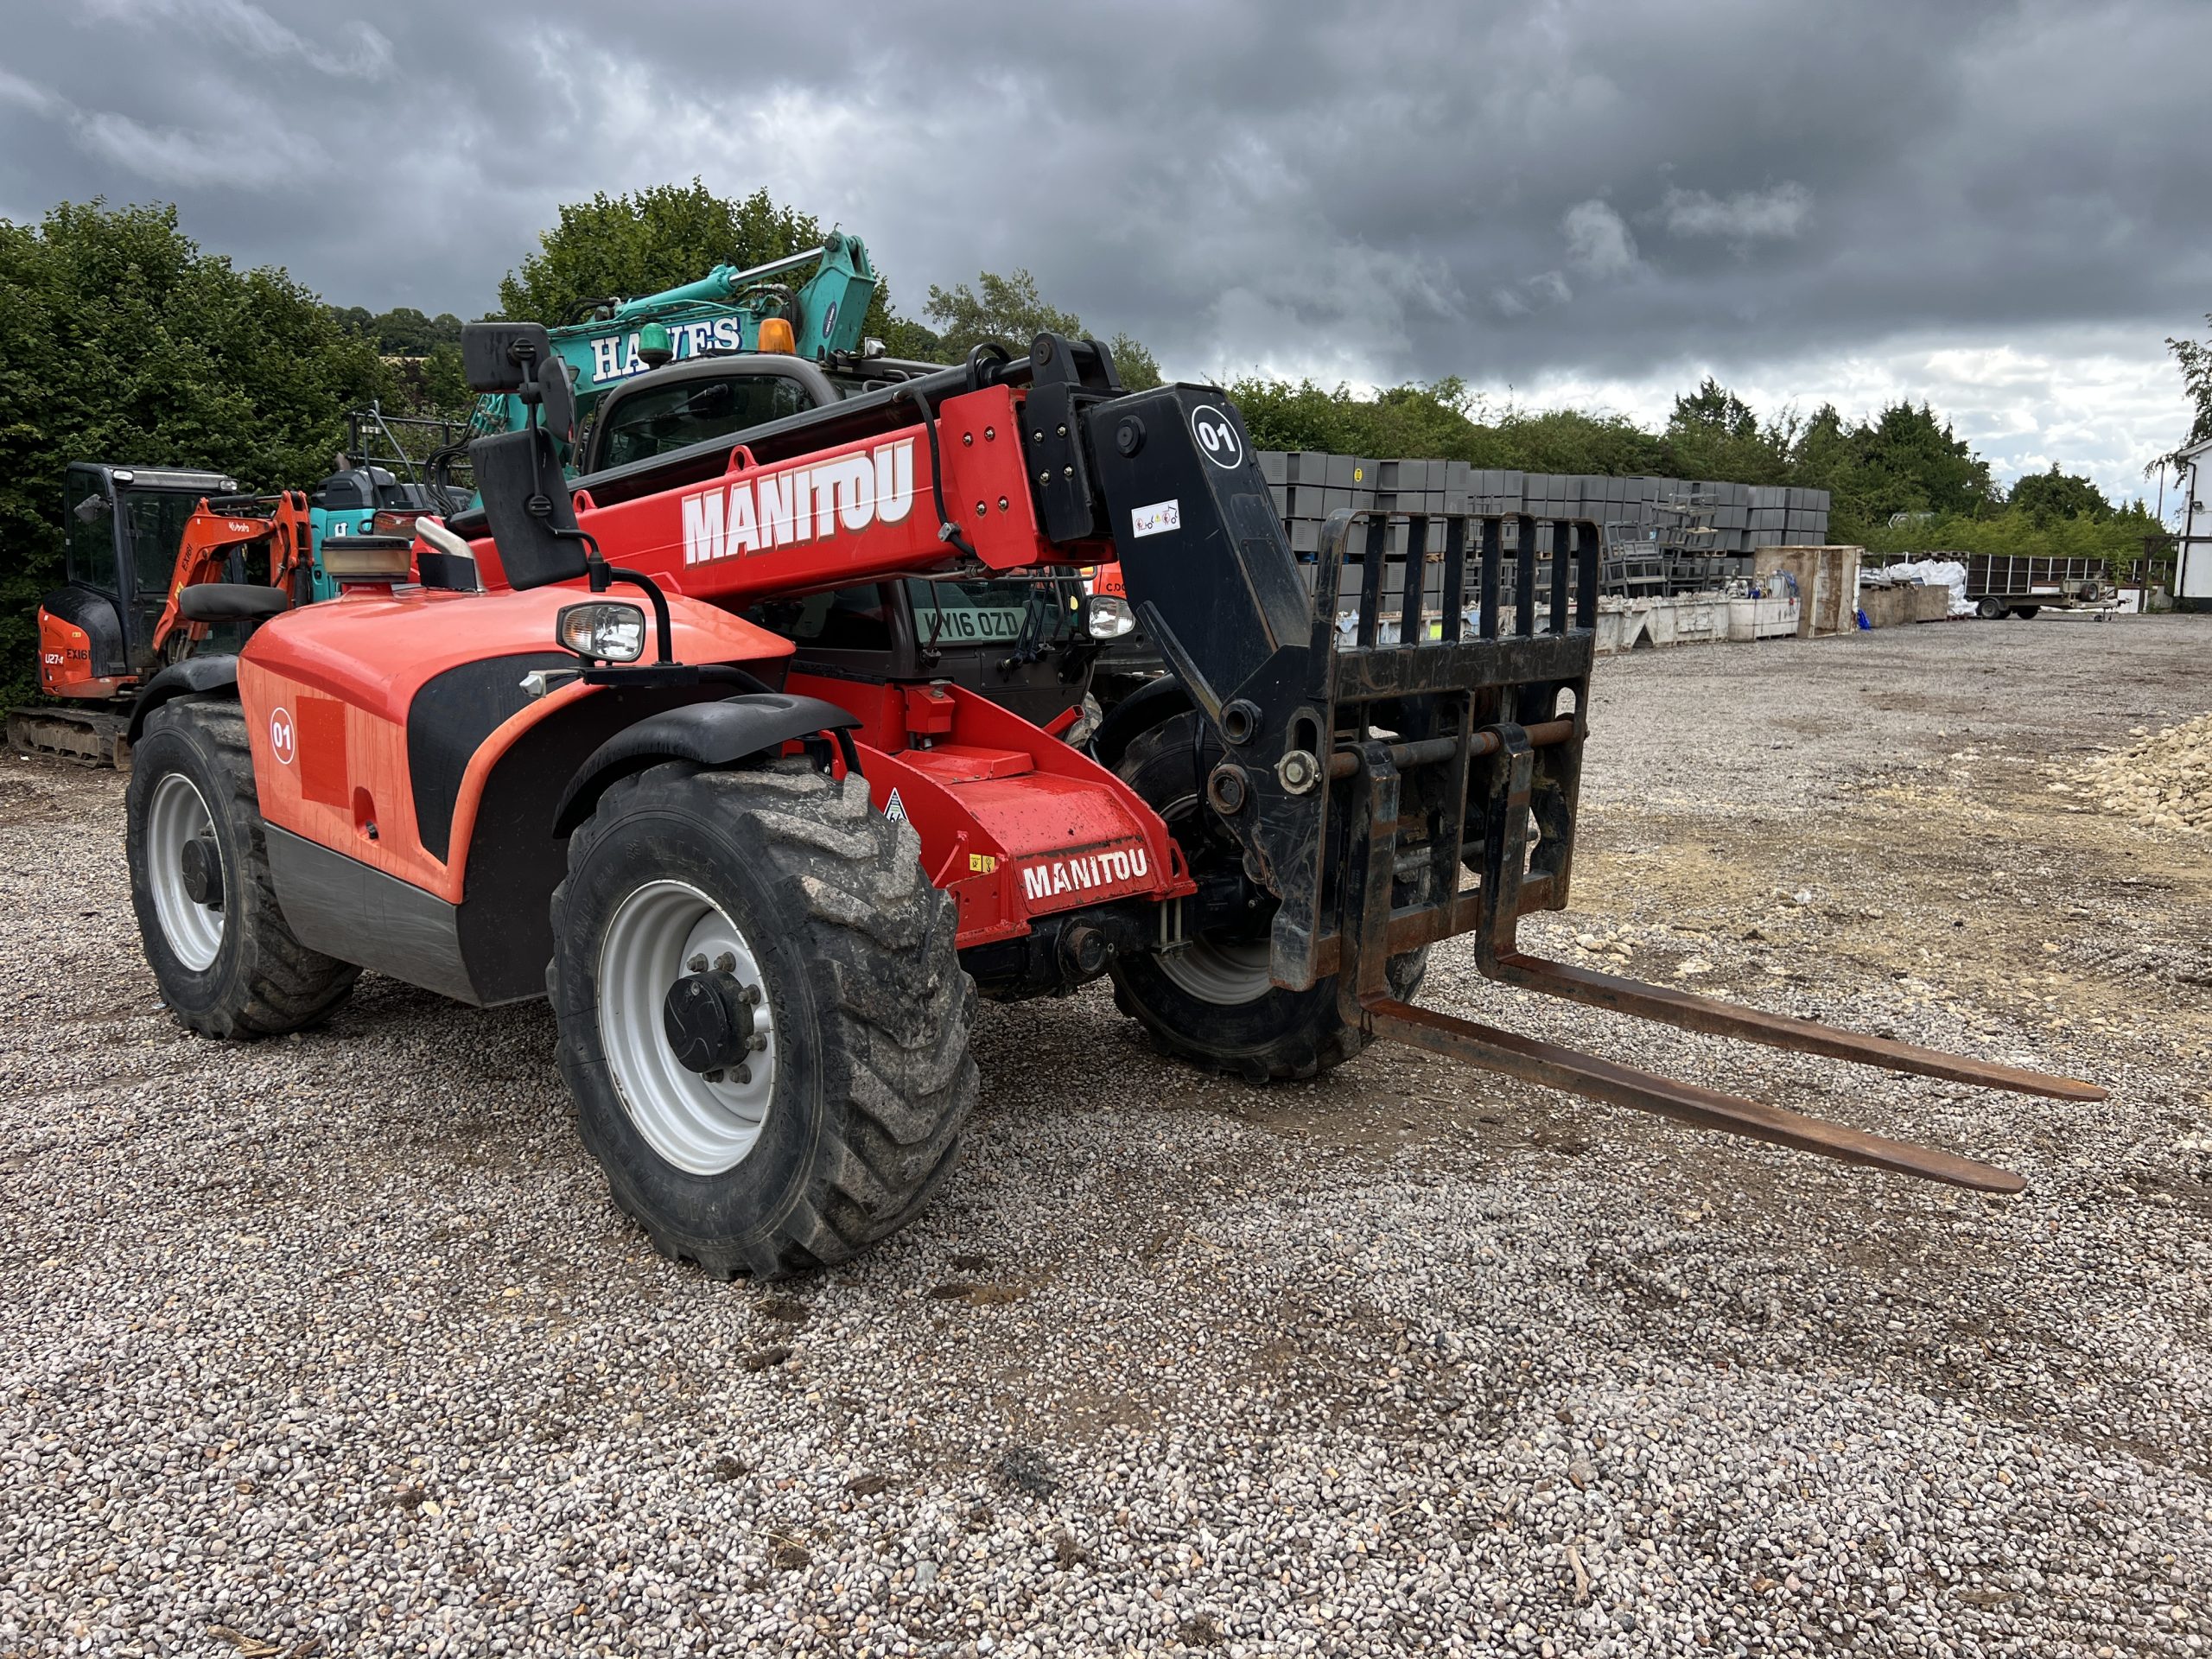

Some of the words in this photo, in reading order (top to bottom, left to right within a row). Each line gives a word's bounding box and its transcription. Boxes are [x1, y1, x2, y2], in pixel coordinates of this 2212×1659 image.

[1198, 422, 1236, 452] 01
[682, 437, 914, 569] MANITOU
[978, 612, 1020, 636] OZD
[45, 654, 64, 664] U27-4
[273, 721, 291, 750] 01
[1023, 848, 1147, 900] MANITOU
